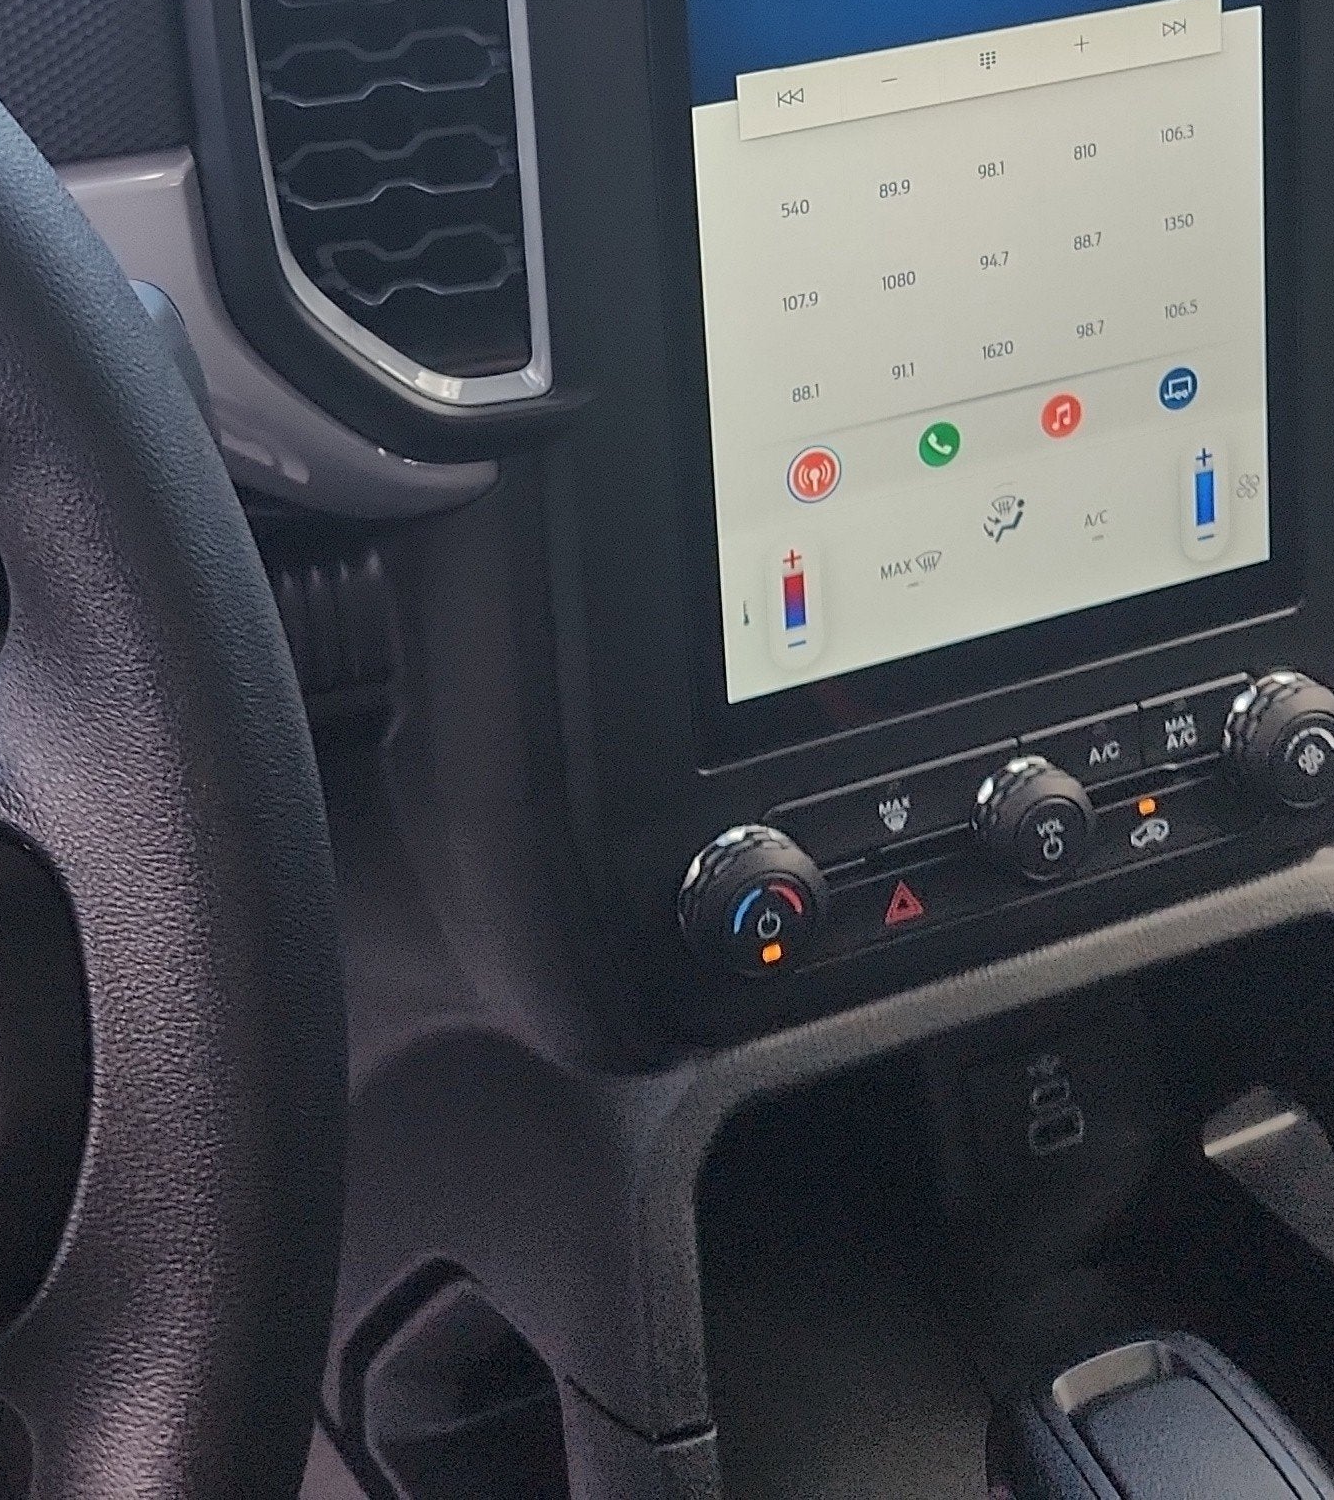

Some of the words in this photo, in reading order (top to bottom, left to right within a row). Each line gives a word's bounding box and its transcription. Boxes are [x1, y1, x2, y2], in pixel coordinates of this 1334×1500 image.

[781, 199, 809, 218] 540
[879, 179, 911, 198] 89.9
[977, 160, 1005, 179] 98.1
[1073, 143, 1097, 160] 810
[1159, 124, 1194, 143] 106.3
[782, 291, 818, 312] 107.9
[881, 270, 916, 290] 1080
[980, 251, 1009, 270] 94.7
[1073, 231, 1102, 250] 88.7
[1164, 213, 1194, 232] 1350
[792, 383, 820, 402] 88.1
[891, 362, 916, 380] 91.1
[982, 340, 1013, 359] 1620
[1076, 319, 1104, 338] 98.7
[1164, 300, 1198, 319] 106.5
[1084, 509, 1108, 528] A/C
[880, 559, 912, 580] MAX
[1165, 714, 1195, 733] MAX
[1167, 729, 1197, 750] A/C
[1089, 743, 1119, 766] A/C
[878, 796, 911, 818] MAX
[1036, 818, 1064, 838] VOL
